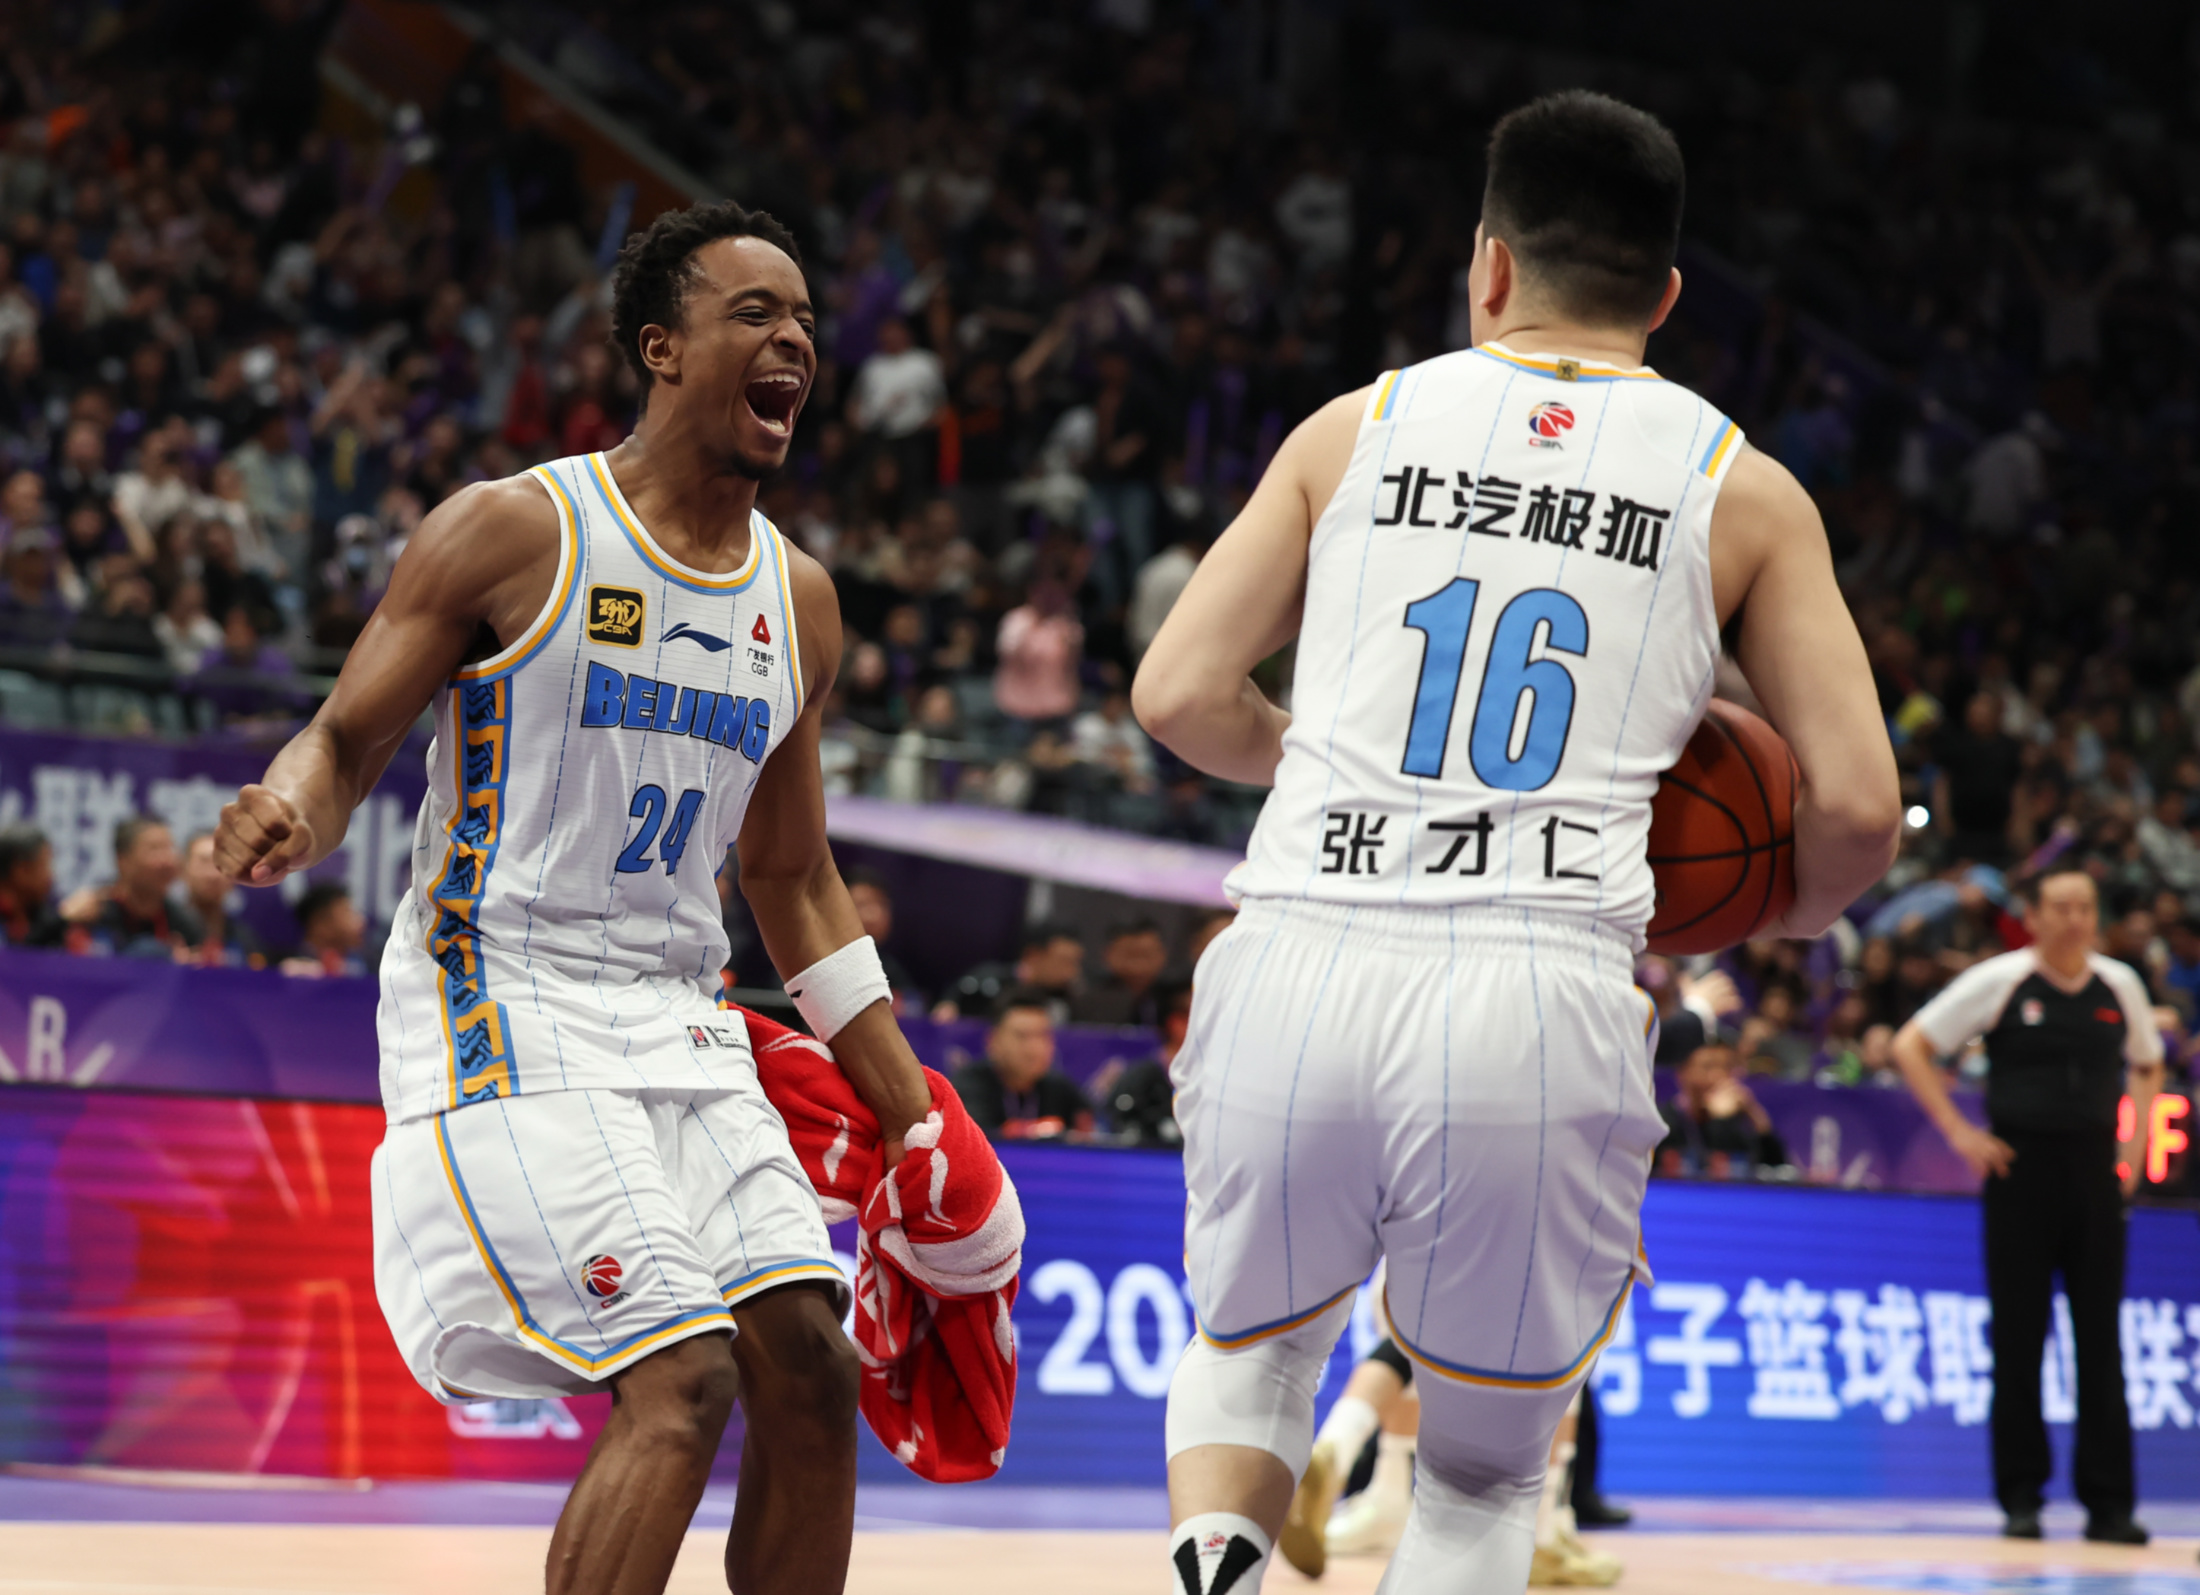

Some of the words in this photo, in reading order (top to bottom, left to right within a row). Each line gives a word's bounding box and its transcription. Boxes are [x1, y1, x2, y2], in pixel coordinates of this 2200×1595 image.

[1373, 465, 1671, 572] 北汽极狐
[603, 623, 633, 637] CBA
[746, 647, 775, 667] 广发银行
[751, 661, 769, 678] CGB
[580, 660, 771, 765] BEIJING
[1400, 576, 1590, 792] 16
[615, 783, 705, 876] 24
[1320, 811, 1600, 882] 张才仁
[1028, 1258, 1193, 1399] 20
